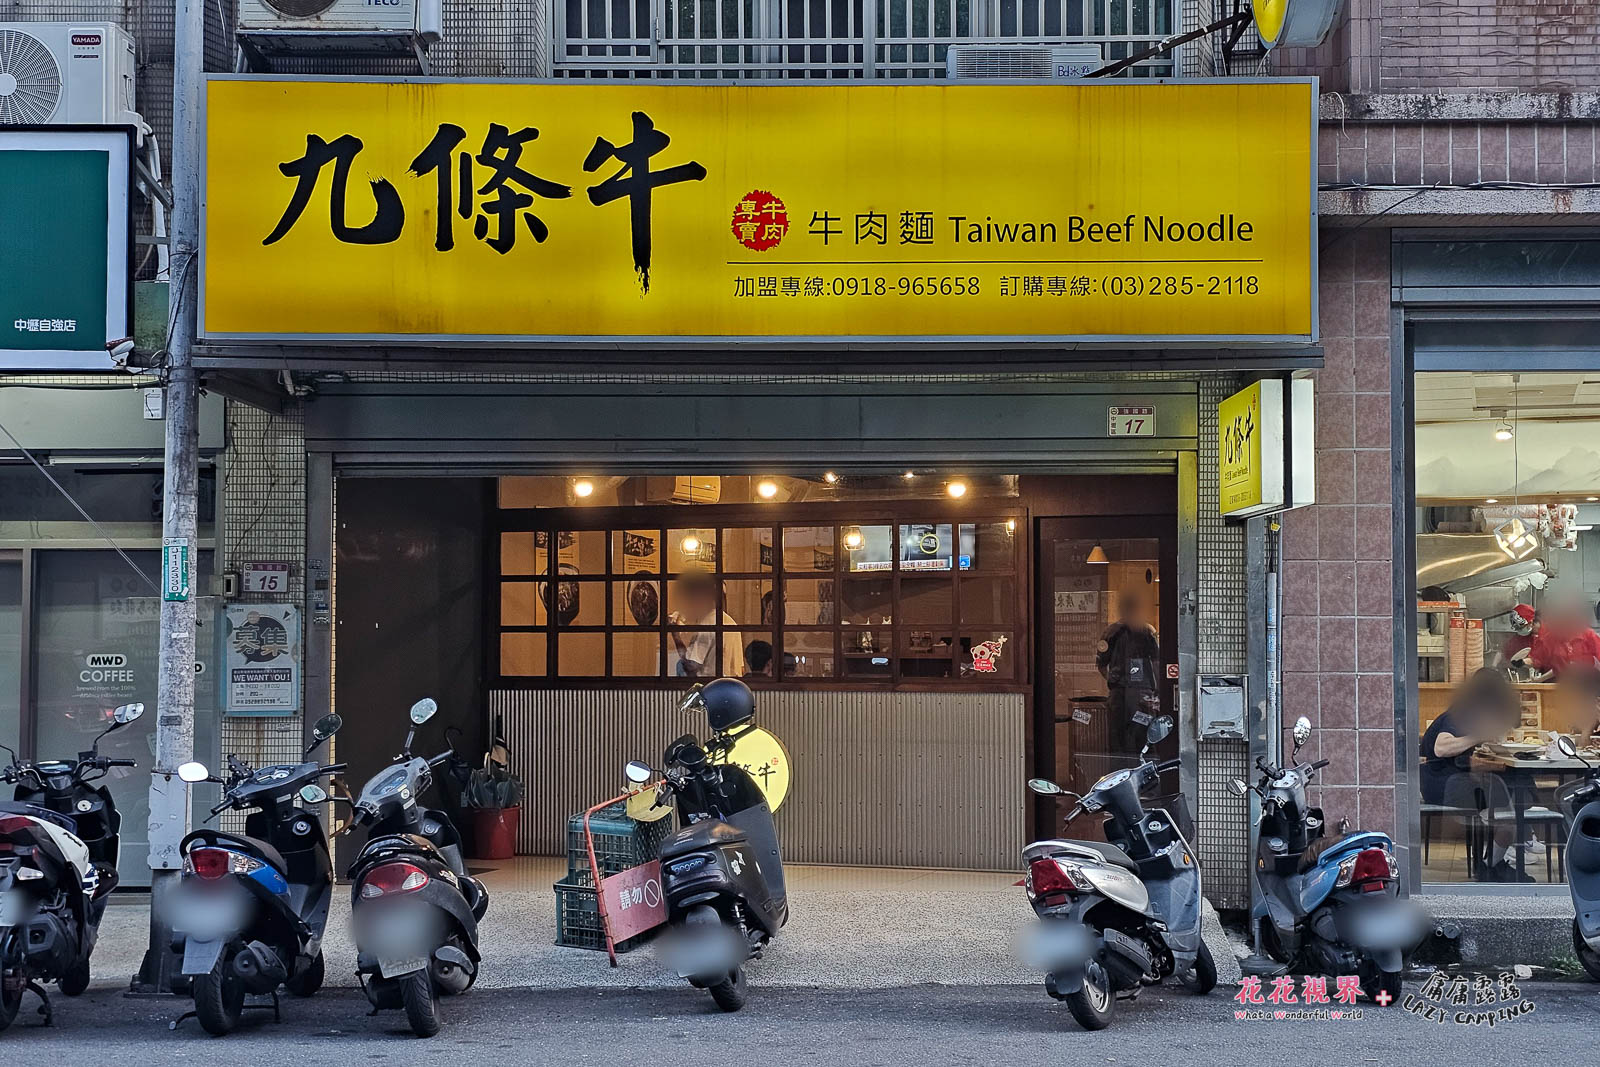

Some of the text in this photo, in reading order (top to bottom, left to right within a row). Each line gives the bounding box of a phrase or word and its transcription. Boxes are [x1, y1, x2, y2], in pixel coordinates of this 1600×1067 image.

[262, 111, 707, 296] 九條牛
[808, 210, 1254, 246] 牛肉麵 Taiwan Beef Noodle
[733, 275, 980, 298] 加盟專線:0918-965658
[14, 318, 77, 332] 中壢自強店
[1125, 419, 1145, 434] 17
[1223, 405, 1254, 476] 九條牛
[259, 575, 279, 590] 15
[232, 625, 289, 657] 募集
[90, 656, 123, 666] MWD
[79, 670, 134, 683] COFFEE
[233, 674, 246, 682] WE
